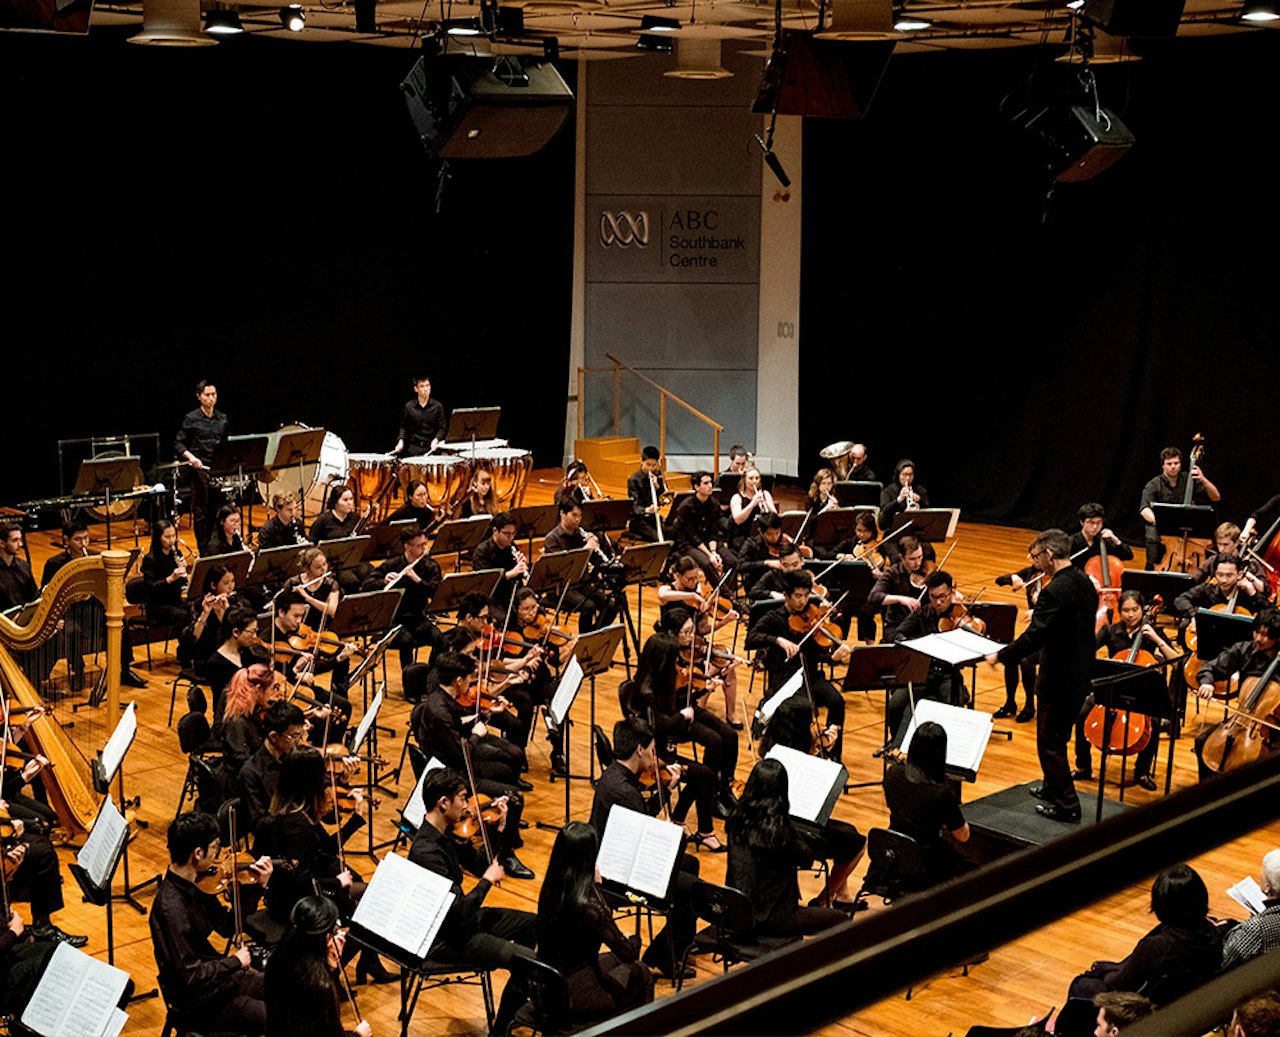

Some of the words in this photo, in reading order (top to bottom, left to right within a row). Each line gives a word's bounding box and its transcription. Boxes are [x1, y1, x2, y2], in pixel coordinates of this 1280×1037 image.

[669, 211, 719, 230] ABC
[669, 235, 746, 249] Southbank
[669, 253, 718, 268] Centre
